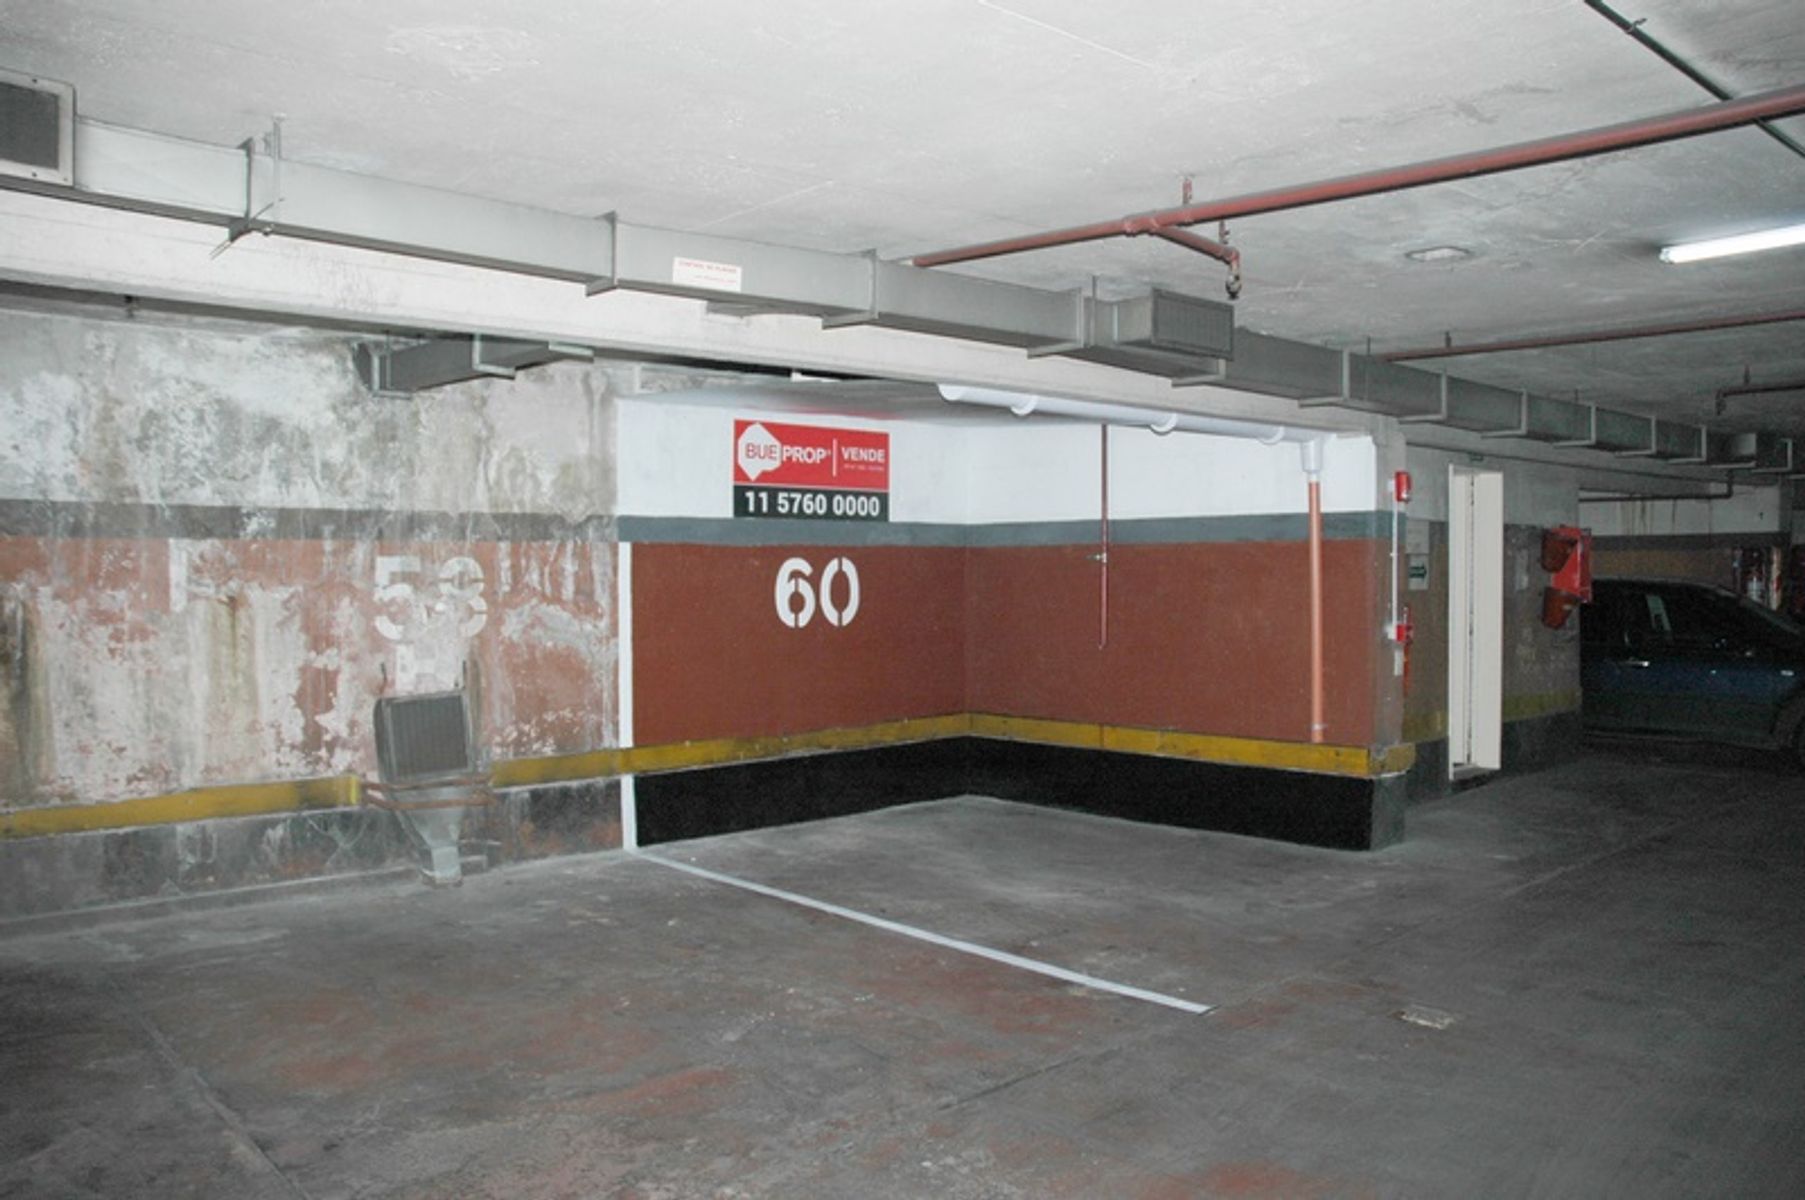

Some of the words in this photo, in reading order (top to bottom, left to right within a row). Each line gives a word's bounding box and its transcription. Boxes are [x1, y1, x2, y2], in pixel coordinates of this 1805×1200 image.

[841, 446, 885, 463] VENDE
[745, 491, 769, 514] 11
[777, 492, 827, 515] 5760
[832, 494, 879, 517] 0000
[774, 556, 860, 629] 60
